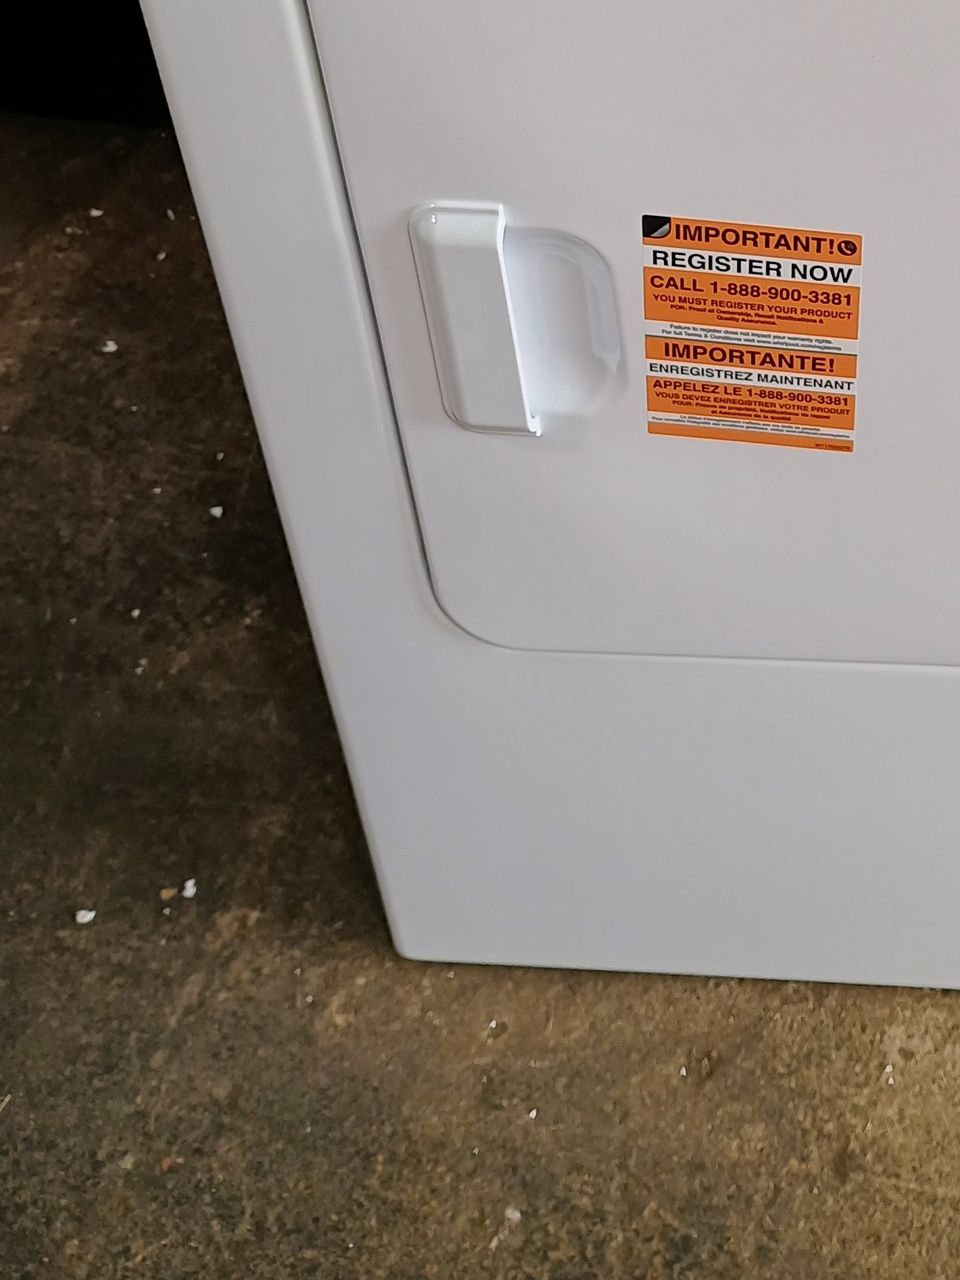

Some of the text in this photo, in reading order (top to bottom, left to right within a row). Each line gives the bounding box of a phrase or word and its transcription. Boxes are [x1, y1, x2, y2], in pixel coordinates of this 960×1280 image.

[675, 224, 834, 254] IMPORTANT!
[652, 250, 853, 283] REGISTER NOW
[650, 275, 852, 306] CALL 1-888-900-3381
[653, 294, 852, 319] YOU MUST REGISTER YOUR PRODUCT
[664, 342, 835, 372] IMPORTANTE!
[650, 363, 853, 390] ENREGISTREZ MAINTENANT
[653, 379, 849, 406] APPELEZ LE 1-888-900-3381
[655, 391, 850, 415] VOUS DEVEZ ENREGISTRER VOTRE PRODUIT
